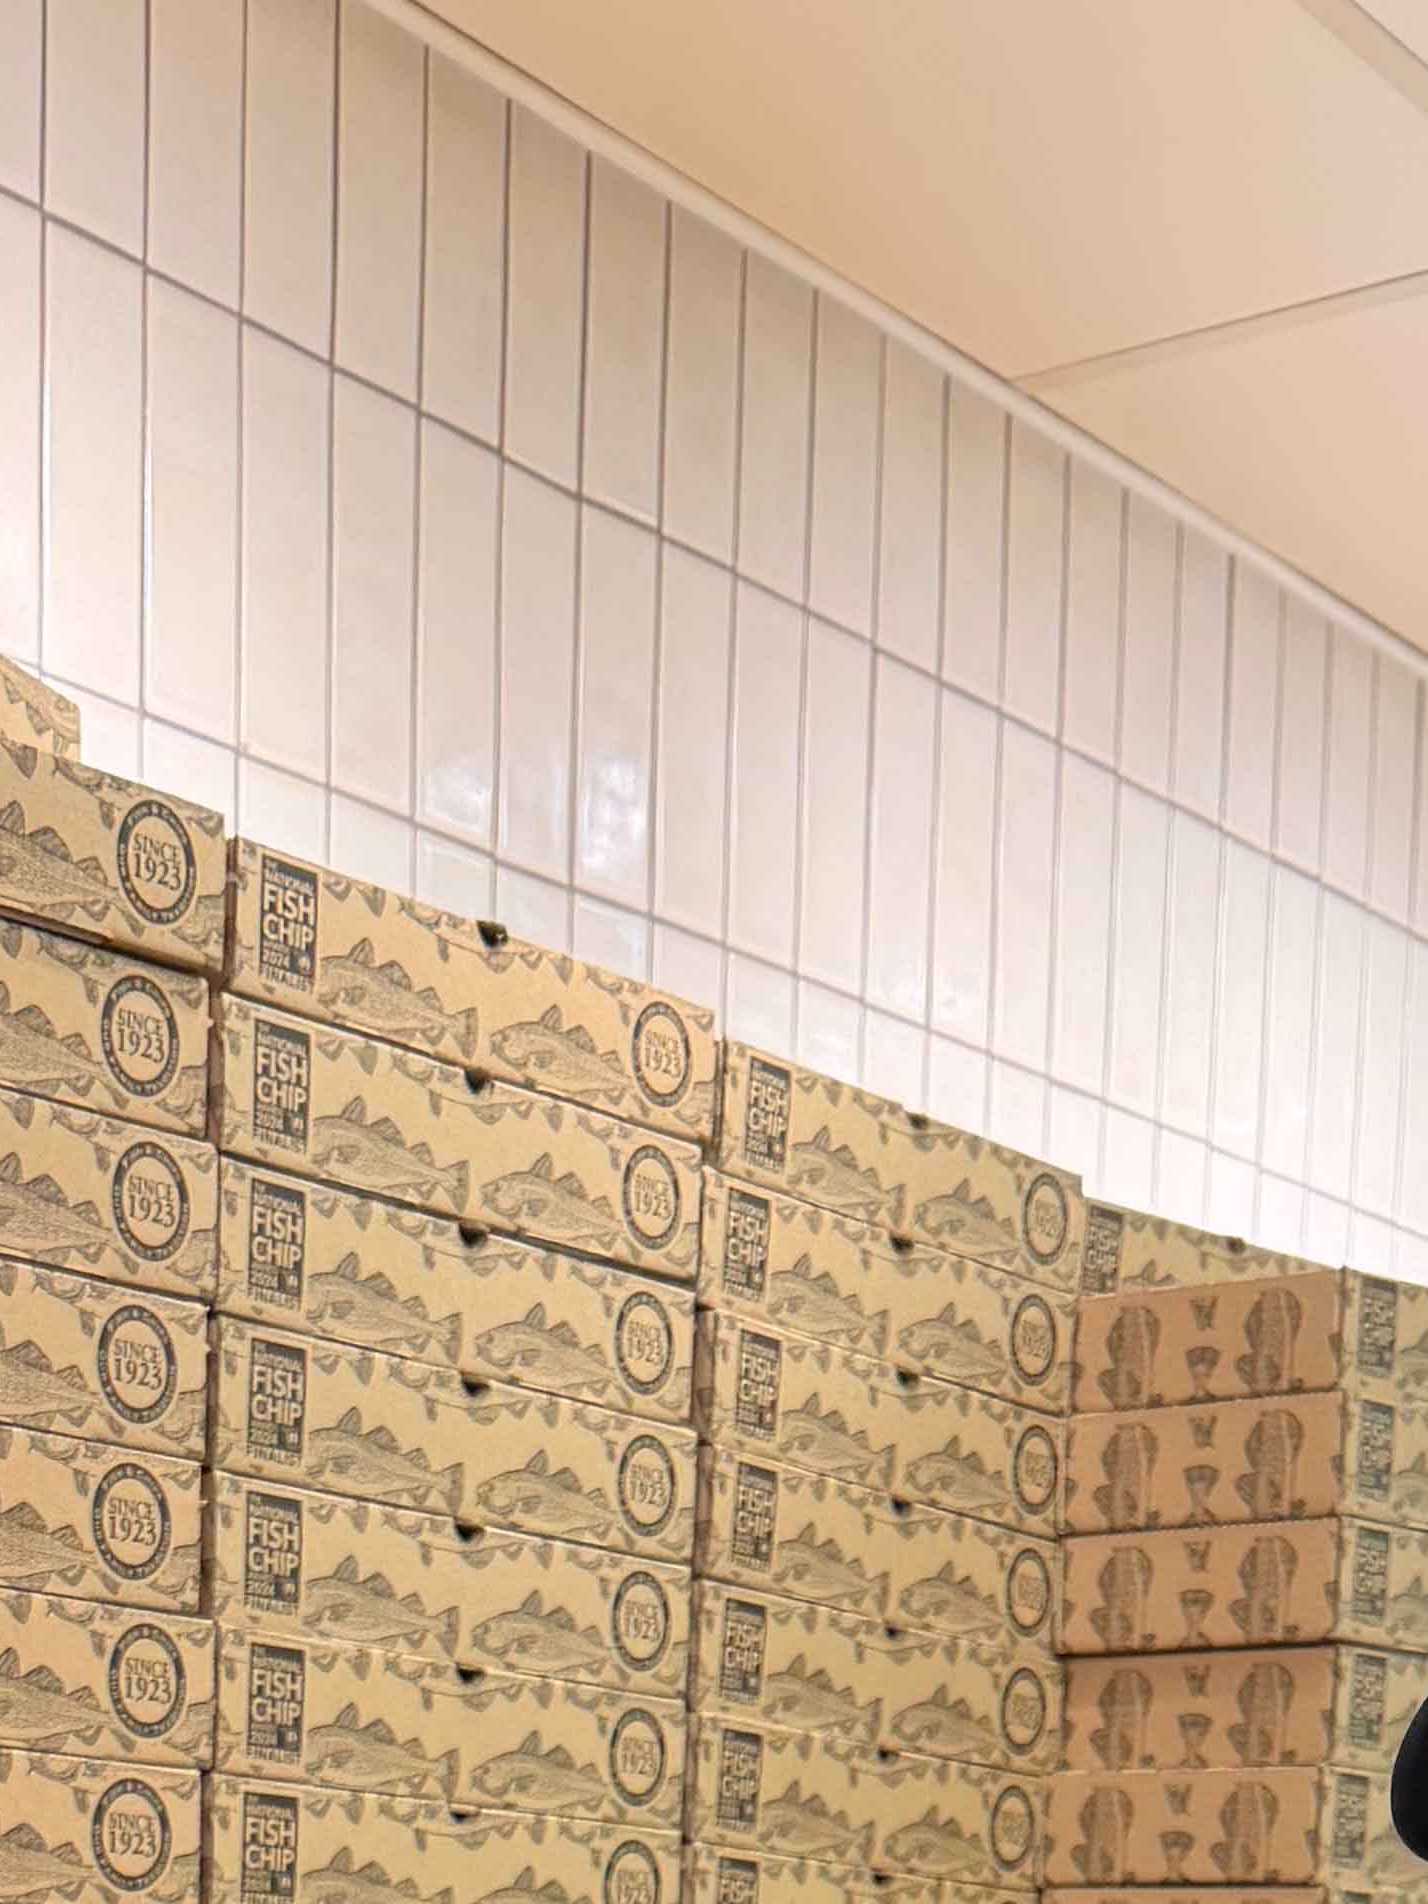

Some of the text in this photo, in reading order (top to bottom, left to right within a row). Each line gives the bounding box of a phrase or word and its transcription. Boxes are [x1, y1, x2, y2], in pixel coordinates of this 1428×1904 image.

[133, 834, 182, 865] SINCE
[134, 854, 181, 893] 1923
[264, 882, 315, 926] FISH
[263, 912, 314, 952] CHIP
[117, 1008, 165, 1037] SINCE
[118, 1028, 164, 1065] 1923
[257, 1045, 308, 1087] FISH
[257, 1076, 307, 1113] CHIP
[128, 1175, 175, 1202] SINCE
[129, 1195, 175, 1229] 1923
[253, 1205, 303, 1245] FISH
[252, 1235, 301, 1270] CHIP
[114, 1339, 162, 1364] SINCE
[115, 1358, 162, 1391] 1923
[108, 1497, 156, 1520] SINCE
[110, 1516, 156, 1547] 1923
[249, 1517, 299, 1552] FISH
[248, 1546, 298, 1577] CHIP
[125, 1658, 172, 1679] SINCE
[126, 1676, 171, 1705] 1923
